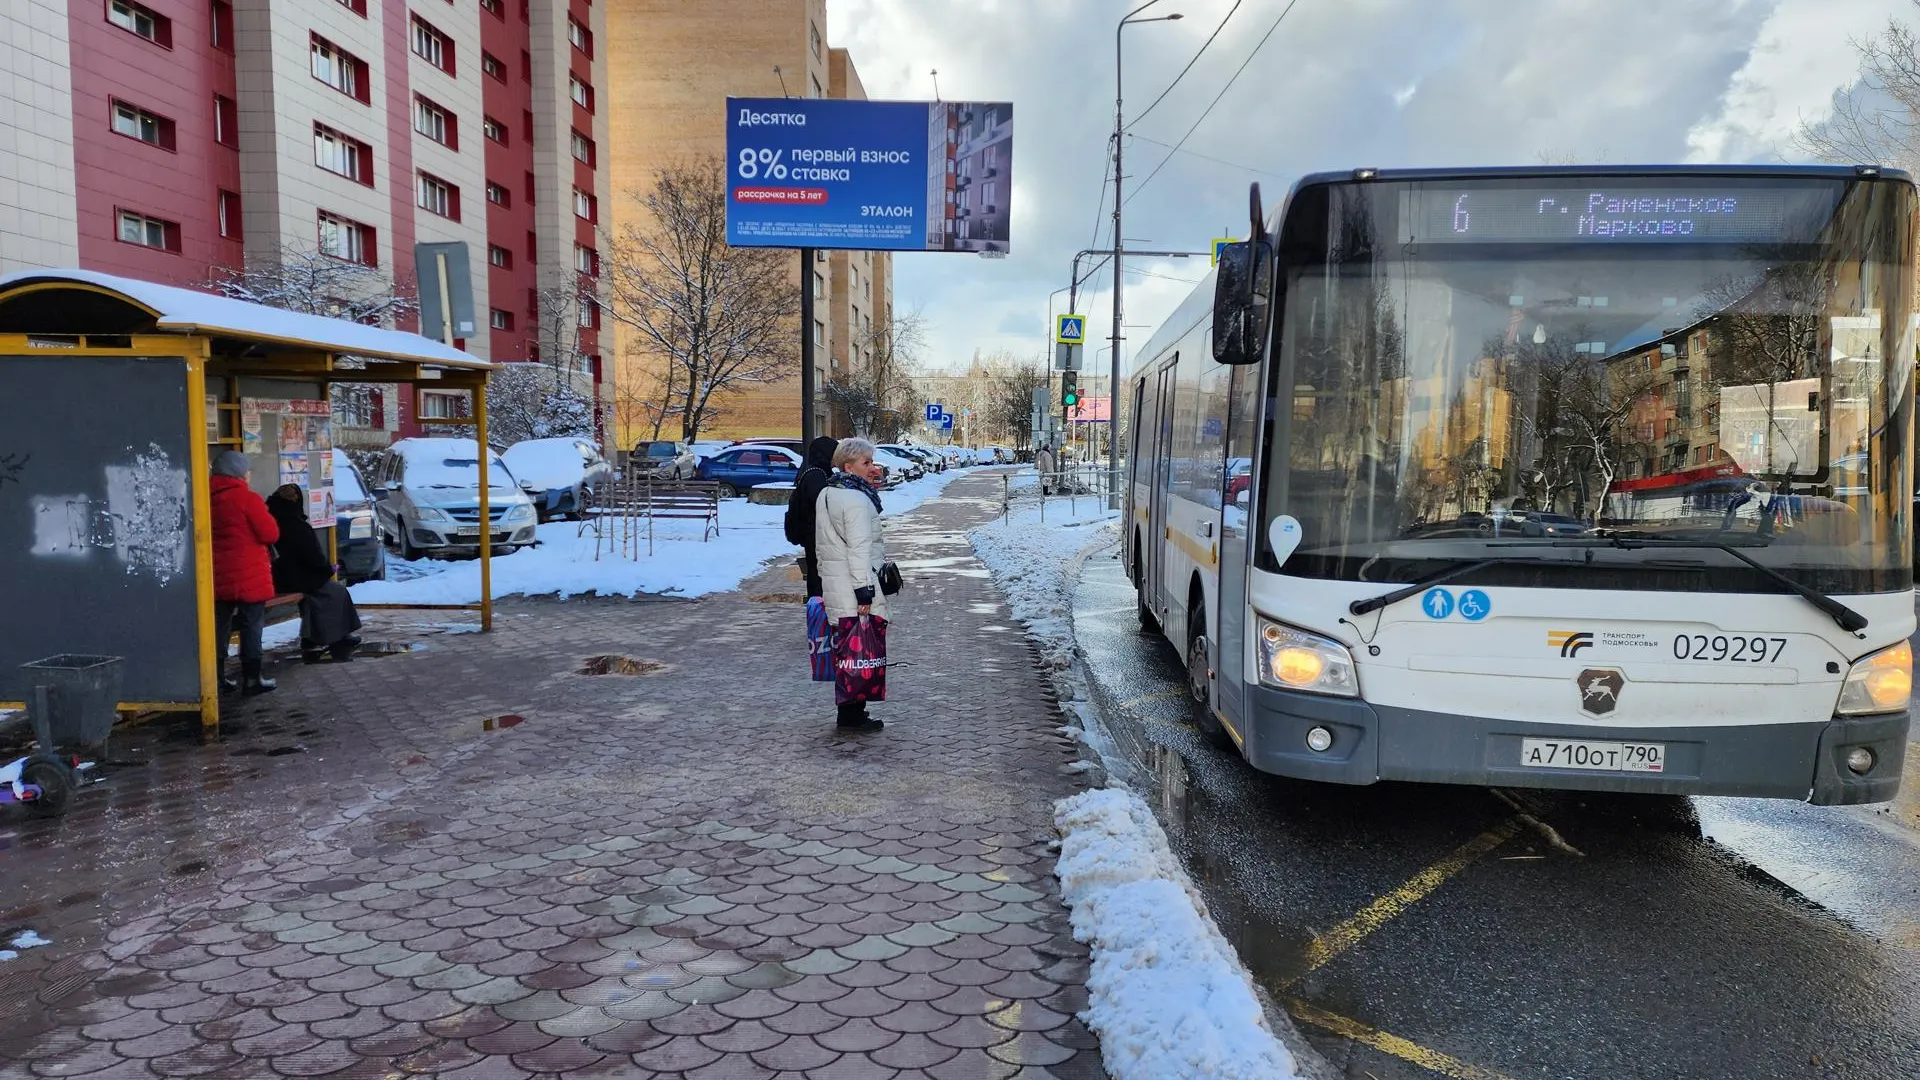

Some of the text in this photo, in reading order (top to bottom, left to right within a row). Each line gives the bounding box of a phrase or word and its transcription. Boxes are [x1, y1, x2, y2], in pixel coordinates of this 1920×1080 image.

[738, 108, 806, 127] Десятка
[738, 147, 788, 179] 8%
[791, 146, 910, 167] первый взнос
[791, 167, 850, 181] ставка
[738, 190, 785, 200] рассрочка
[800, 190, 806, 199] 5
[807, 192, 823, 200] лет
[1538, 192, 1738, 215] г. Раменское
[861, 205, 913, 217] ЭТАЛОН
[1453, 193, 1471, 233] 6
[1577, 214, 1694, 237] Марково
[930, 406, 939, 419] P
[1602, 639, 1659, 647] ПОДМОСКОВЬЯ
[1672, 634, 1787, 663] 029297
[1624, 745, 1659, 763] 790
[1631, 762, 1649, 770] RUS
